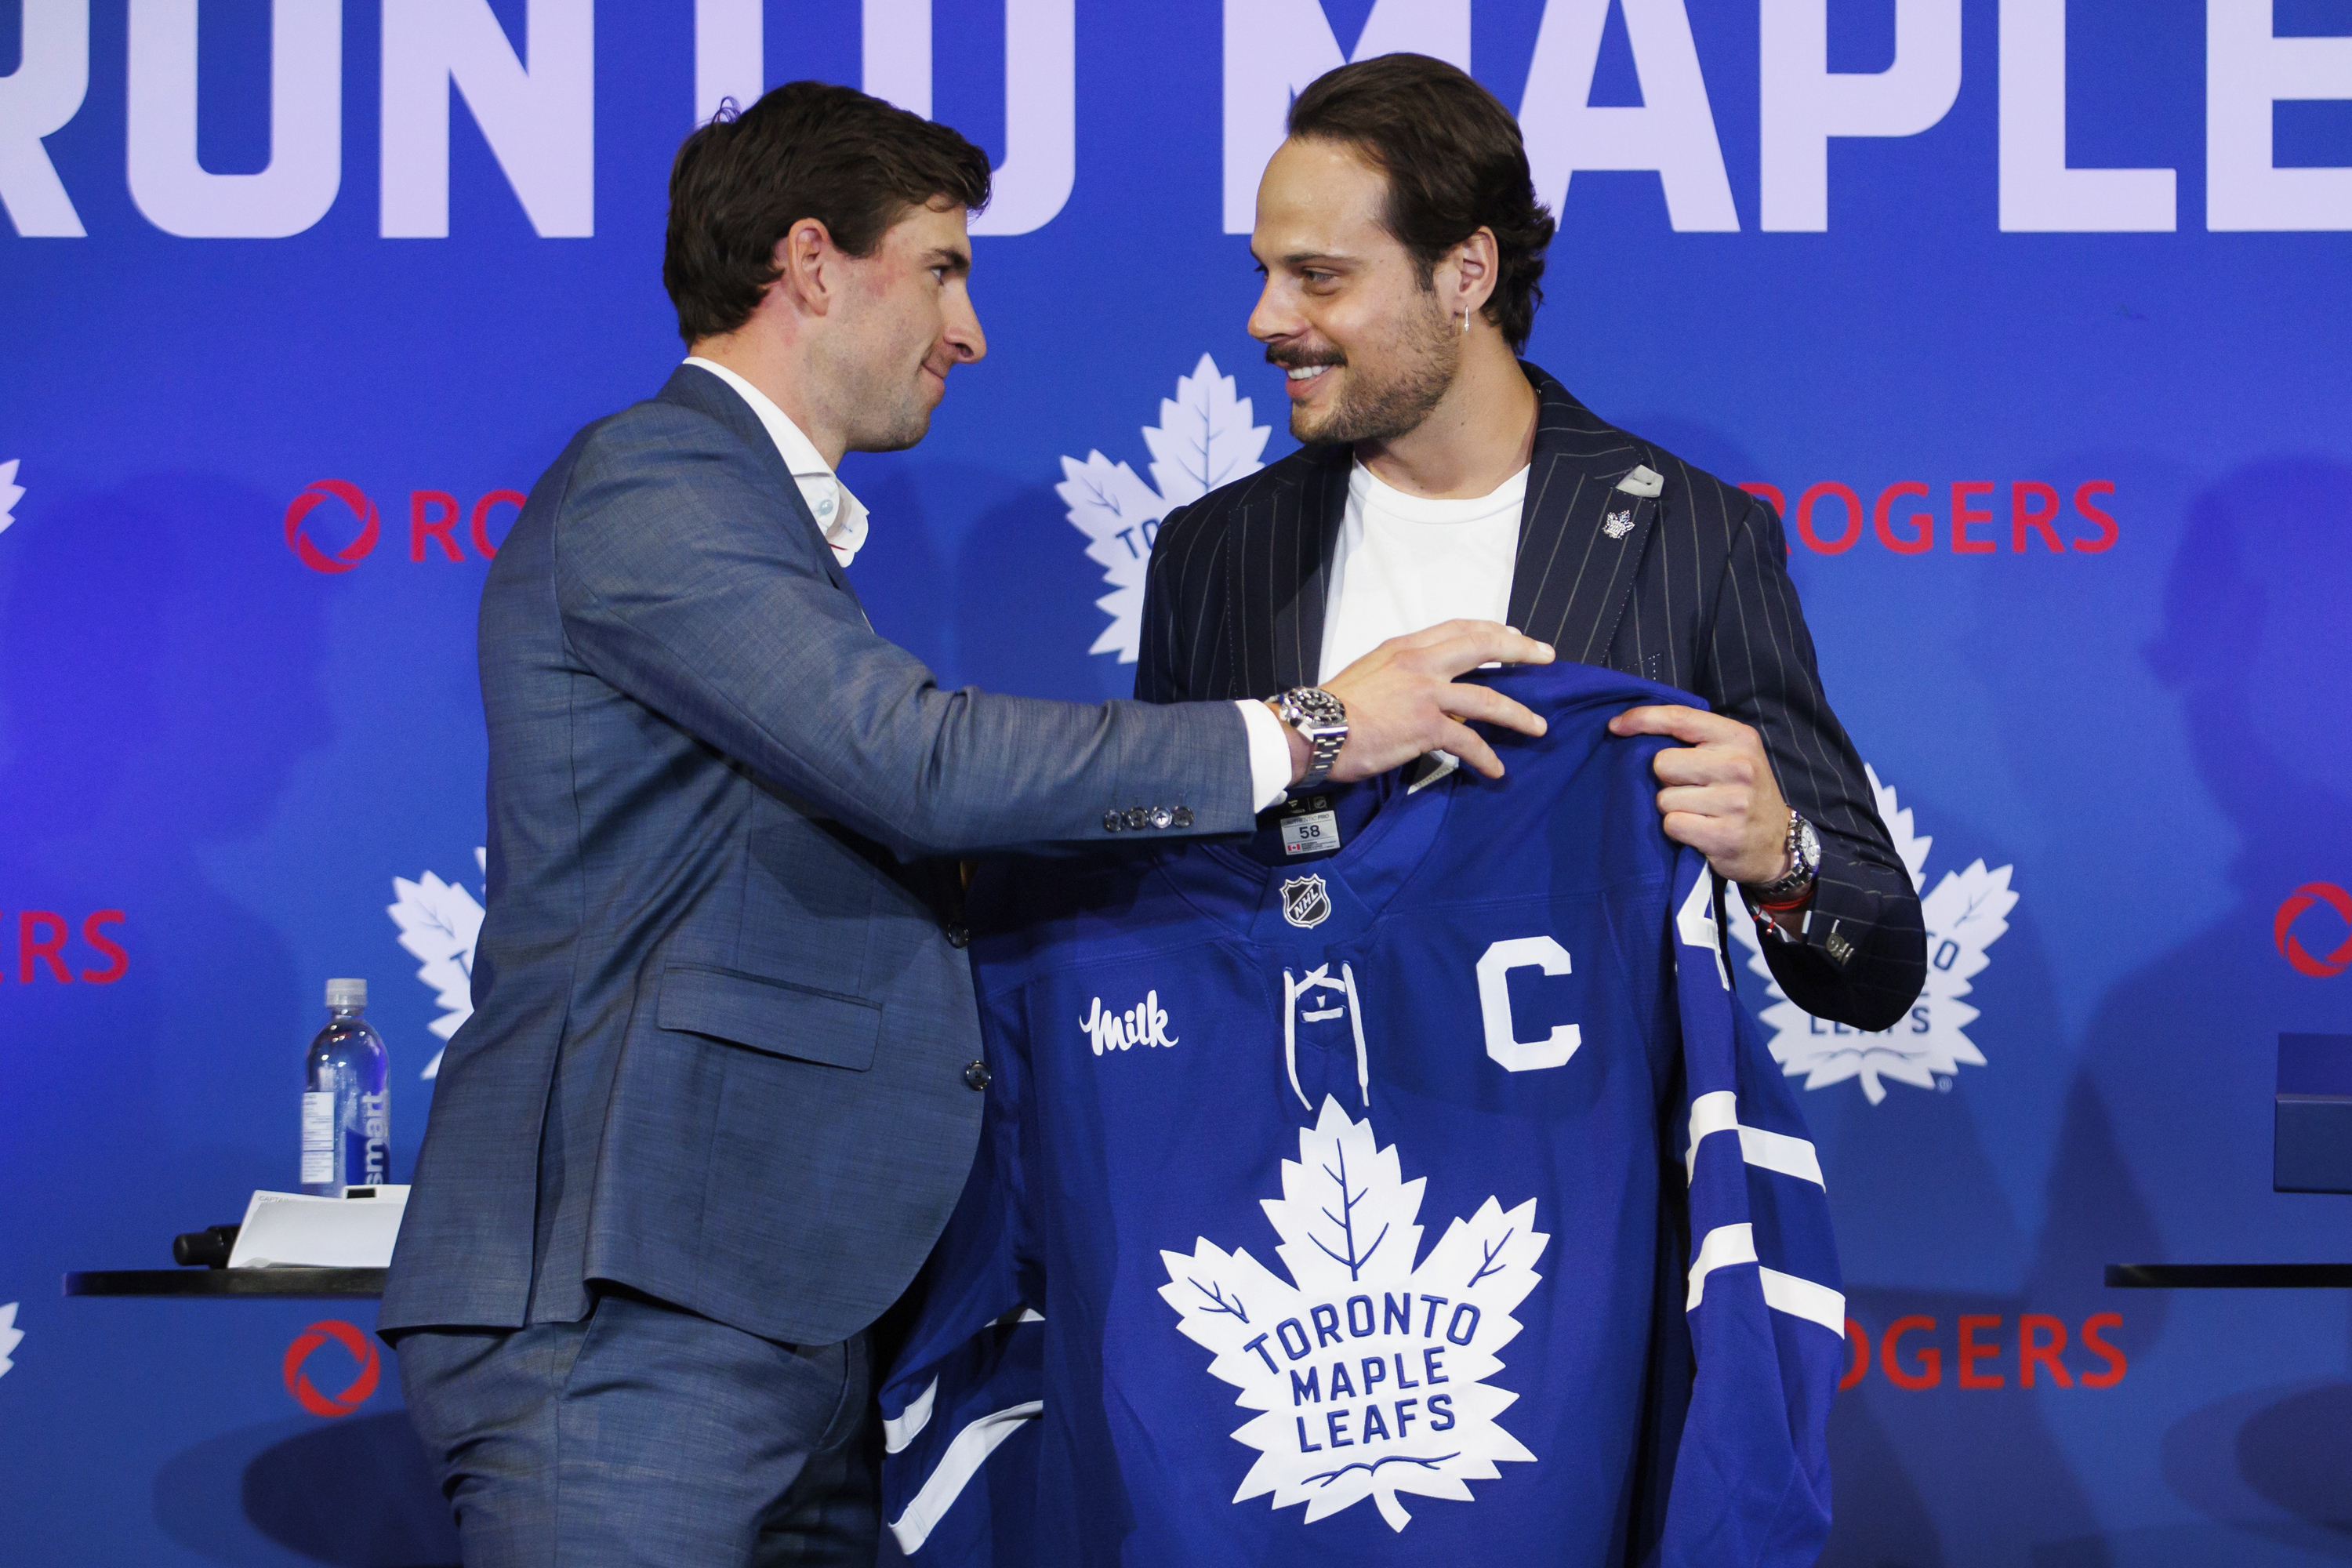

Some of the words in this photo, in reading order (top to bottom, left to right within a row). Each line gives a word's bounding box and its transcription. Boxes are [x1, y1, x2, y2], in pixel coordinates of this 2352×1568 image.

[1299, 825, 1320, 839] 58
[1294, 888, 1319, 919] NHL
[1079, 989, 1179, 1056] Milk
[1475, 935, 1582, 1073] C
[1243, 1292, 1482, 1375] TORONTO
[1290, 1345, 1450, 1406] MAPLE
[1296, 1393, 1456, 1453] LEAFS
